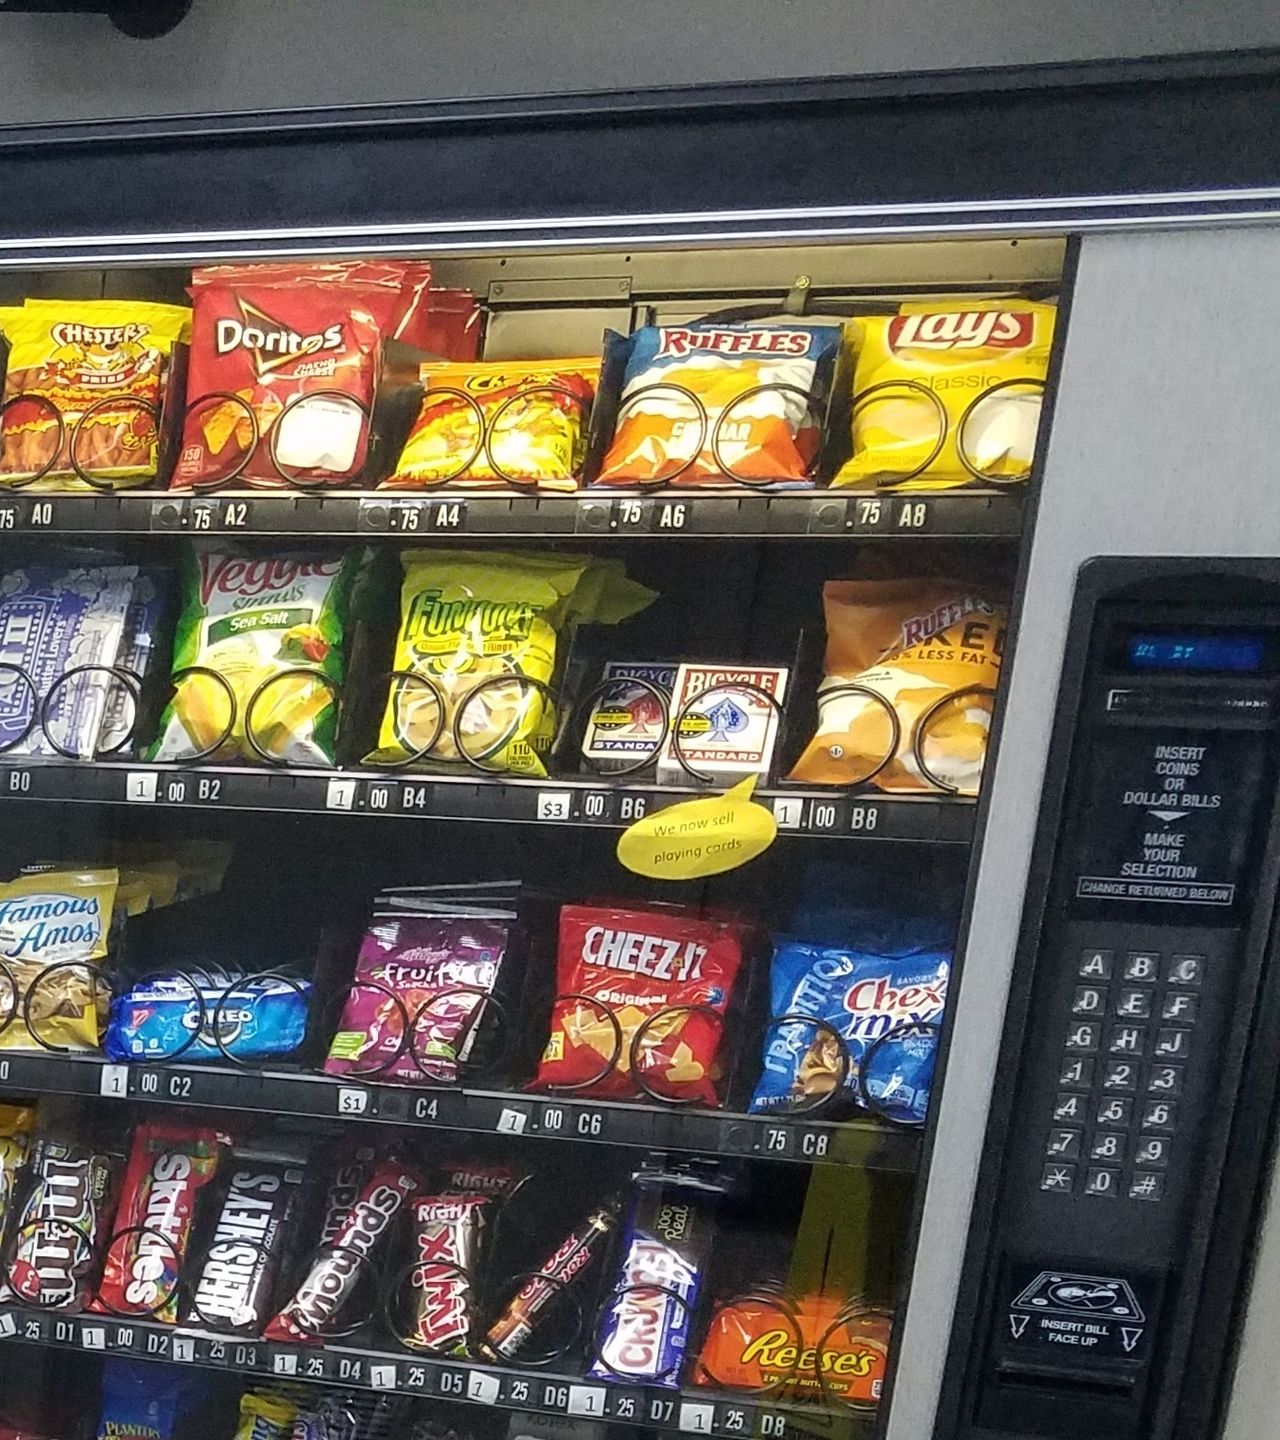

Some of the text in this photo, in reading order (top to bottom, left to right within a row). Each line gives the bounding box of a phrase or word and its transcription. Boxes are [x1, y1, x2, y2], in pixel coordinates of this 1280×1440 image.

[217, 319, 343, 354] Doritos
[654, 328, 812, 360] RUFFLES
[907, 372, 1003, 394] Classic
[31, 504, 53, 527] A0
[224, 504, 247, 527] A2
[436, 504, 460, 527] A4
[659, 504, 686, 529] A6
[899, 503, 927, 529] A8
[229, 611, 290, 632] Sea Salt
[918, 649, 988, 665] LESS FAT
[686, 671, 773, 702] BICYCLE
[1154, 746, 1207, 761] INSERT
[1156, 762, 1200, 777] COINS
[9, 772, 30, 792] B0
[198, 778, 221, 801] B2
[1164, 778, 1185, 792] OR
[401, 786, 426, 809] B4
[620, 798, 646, 820] B6
[1123, 792, 1222, 809] DOLLAR BILLS
[653, 811, 735, 838] We now sell
[851, 805, 878, 830] B8
[653, 837, 743, 865] playing cards
[1143, 832, 1185, 848] MAKE
[1143, 848, 1181, 863] YOUR
[1121, 862, 1198, 879] SELECTION
[1081, 880, 1231, 901] CHANGE RETURNED BELOW
[6, 921, 99, 957] Amos
[1089, 954, 1197, 981] A B C
[844, 974, 946, 1014] Chex
[1082, 990, 1190, 1016] D E F
[182, 1010, 253, 1030] OREO
[1076, 1026, 1183, 1053] G H J
[1071, 1061, 1176, 1089] 1 2 3
[169, 1077, 191, 1097] C2
[415, 1097, 438, 1120] C4
[1062, 1097, 1170, 1125] 4 5 6
[577, 1112, 601, 1135] C6
[802, 1133, 829, 1156] C8
[1060, 1132, 1163, 1161] 7 8 9
[1096, 1171, 1111, 1192] 0
[418, 1202, 473, 1223] RIGHT
[665, 1204, 689, 1241] Real
[125, 1153, 191, 1305] Skittles
[194, 1172, 281, 1318] HERSHEY'S
[294, 1185, 402, 1333] Mounds
[55, 1321, 75, 1342] D1
[1040, 1318, 1110, 1336] INSERT BILL
[147, 1336, 169, 1357] D2
[1048, 1333, 1099, 1347] FACE UP
[235, 1345, 257, 1366] D3
[339, 1358, 362, 1380] D4
[441, 1371, 463, 1394] D5
[544, 1385, 567, 1408] D6
[650, 1398, 673, 1422] D7
[105, 1421, 161, 1440] PLANTERS
[761, 1413, 786, 1437] D8
